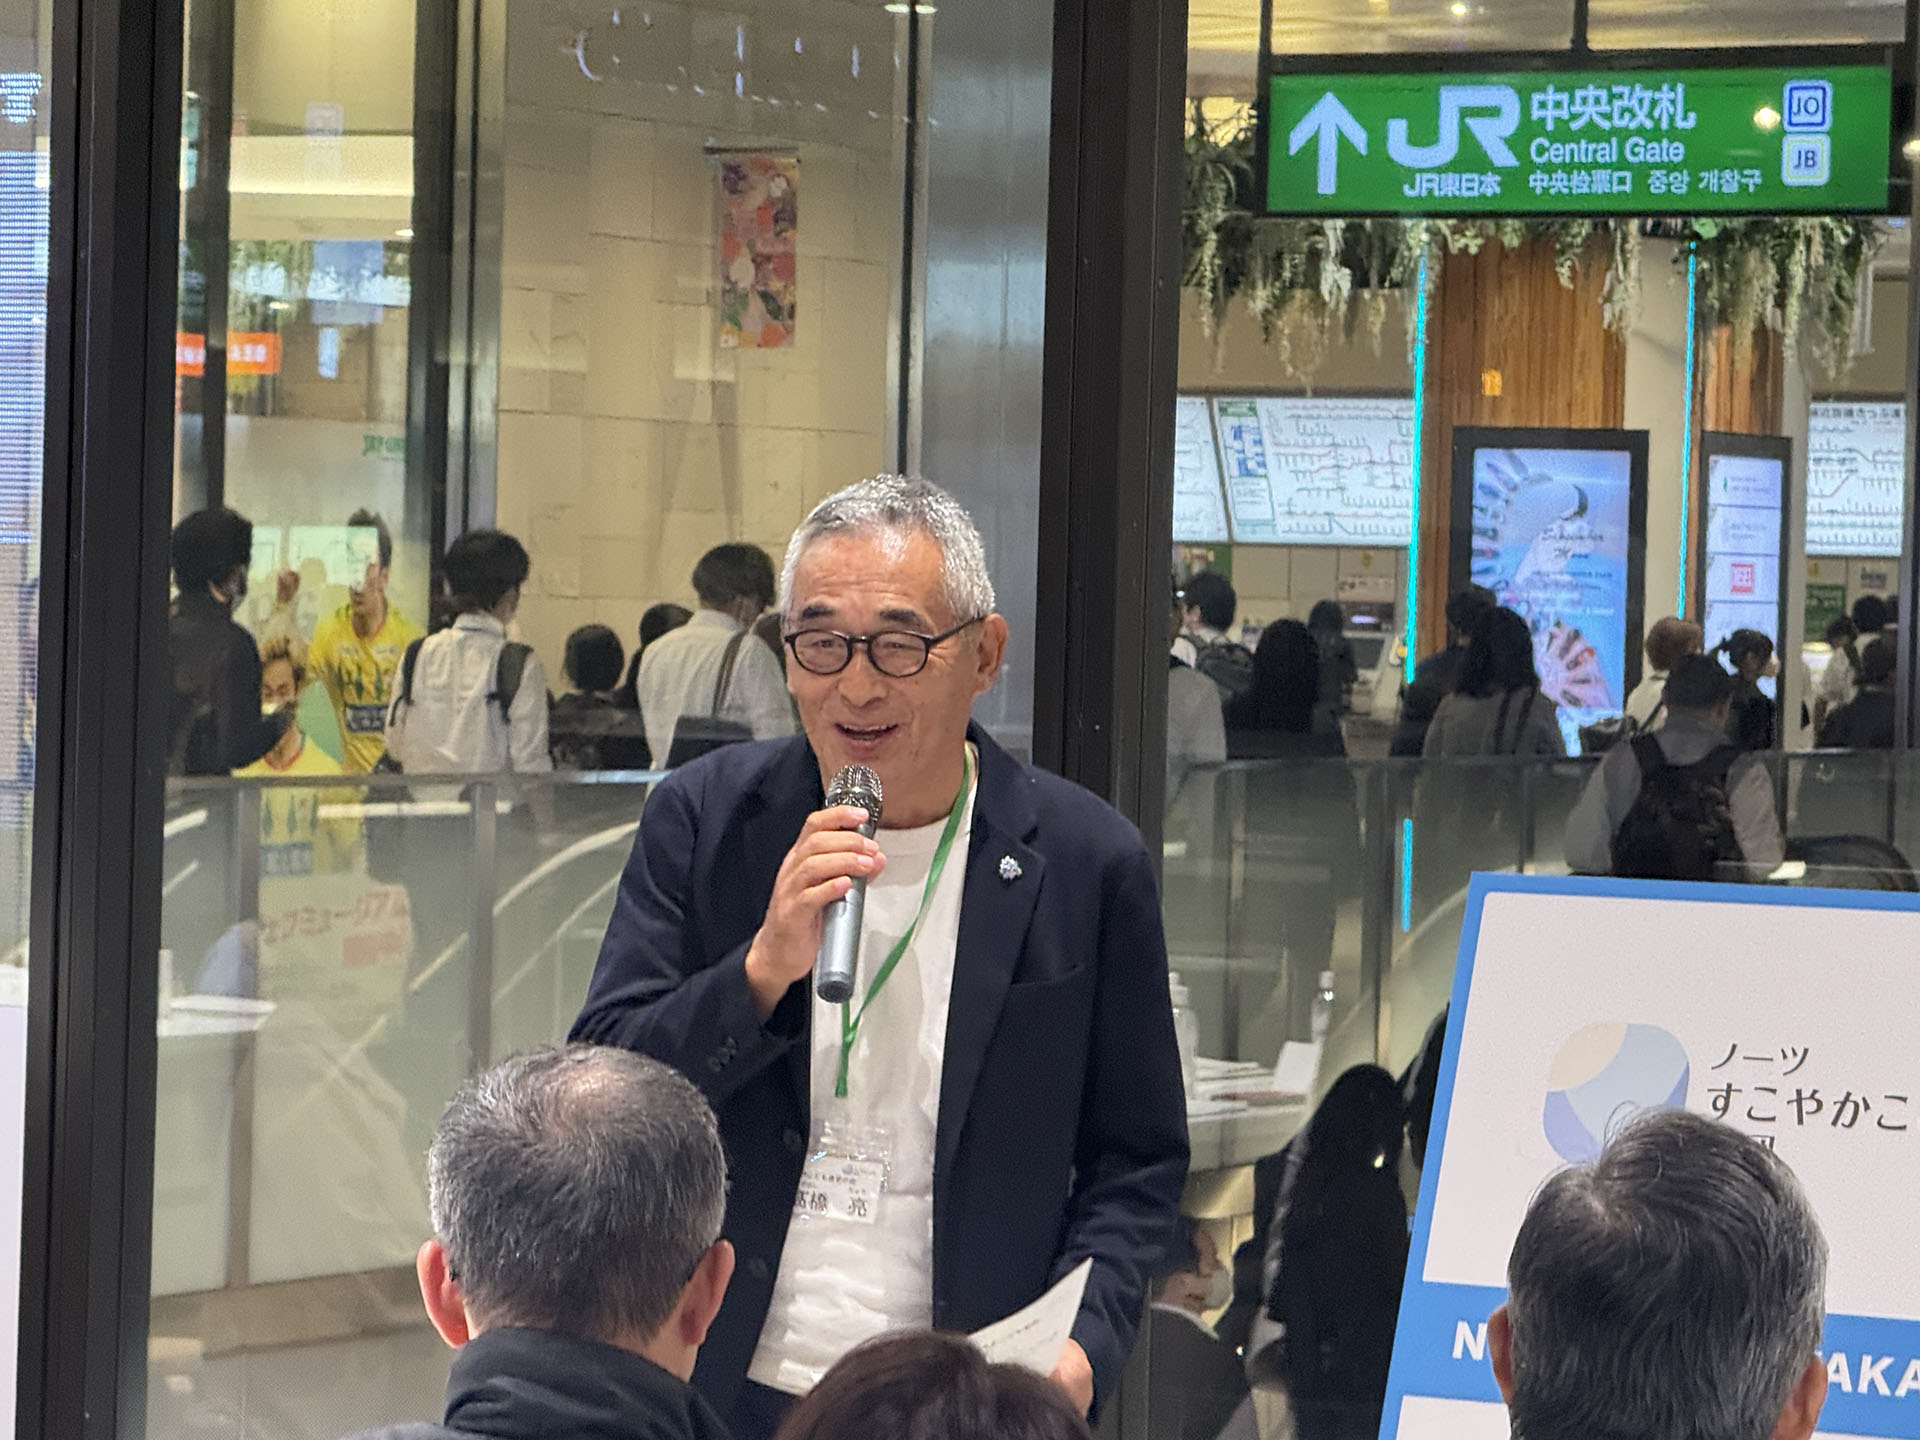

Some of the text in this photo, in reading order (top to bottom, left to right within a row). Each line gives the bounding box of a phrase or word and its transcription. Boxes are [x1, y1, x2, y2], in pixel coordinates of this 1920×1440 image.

[1531, 83, 1697, 132] 中央改札
[1792, 96, 1819, 116] JO
[1387, 84, 1521, 168] JR
[1530, 136, 1685, 163] Central Gate
[1793, 150, 1817, 169] JB
[1403, 171, 1502, 197] JR東日本
[1648, 168, 1763, 195] 중앙 개찰구
[1711, 1043, 1809, 1076] ノーツ
[1707, 1082, 1908, 1130] すこやかこ
[1452, 1320, 1920, 1398] N AKA
